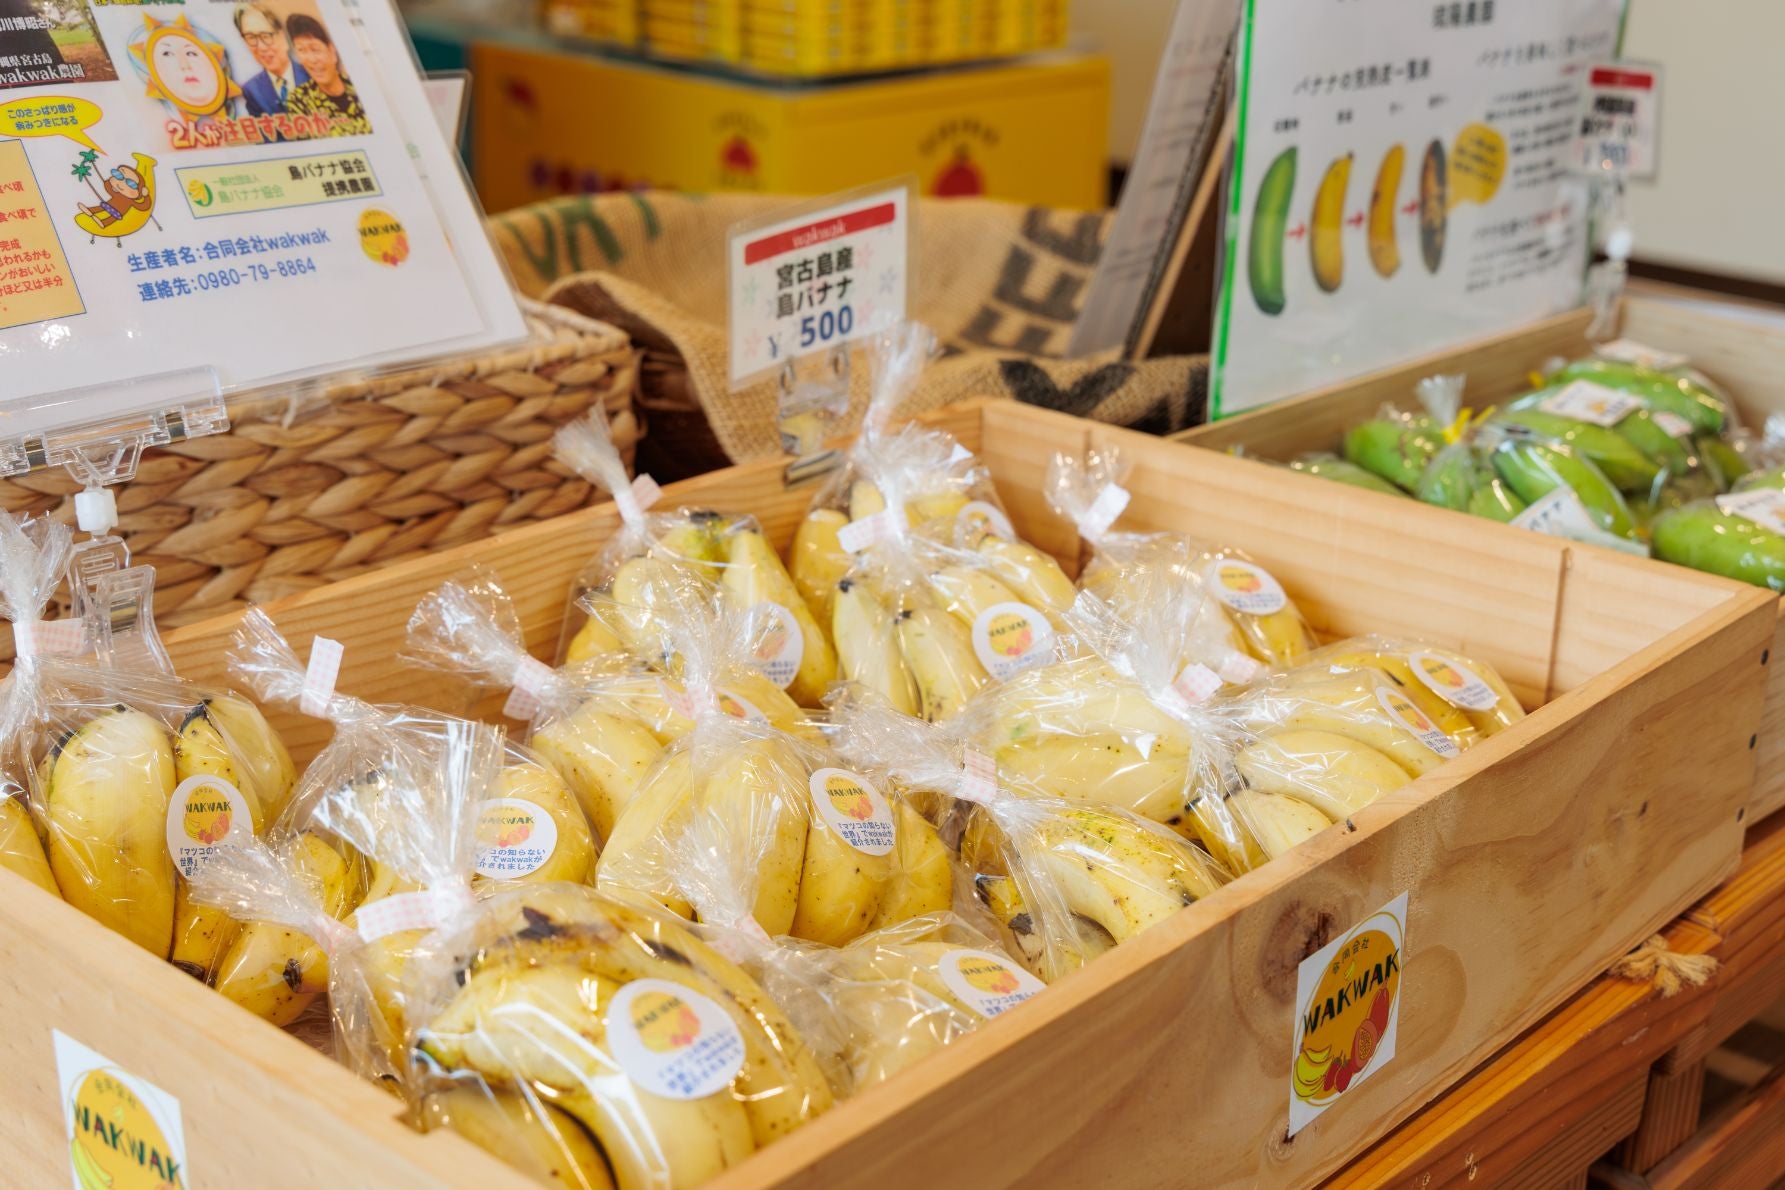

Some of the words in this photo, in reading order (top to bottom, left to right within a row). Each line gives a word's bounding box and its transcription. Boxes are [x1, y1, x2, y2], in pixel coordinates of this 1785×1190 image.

[0, 16, 56, 31] 川博昭さん
[288, 158, 367, 181] 島バナナ協会
[776, 247, 854, 290] 宮古島産
[776, 277, 854, 319] 島バナナ
[800, 305, 853, 348] 500
[185, 801, 231, 813] WAKWAK
[1304, 949, 1400, 1036] WAKWAK
[72, 1098, 181, 1184] WAKWAK
